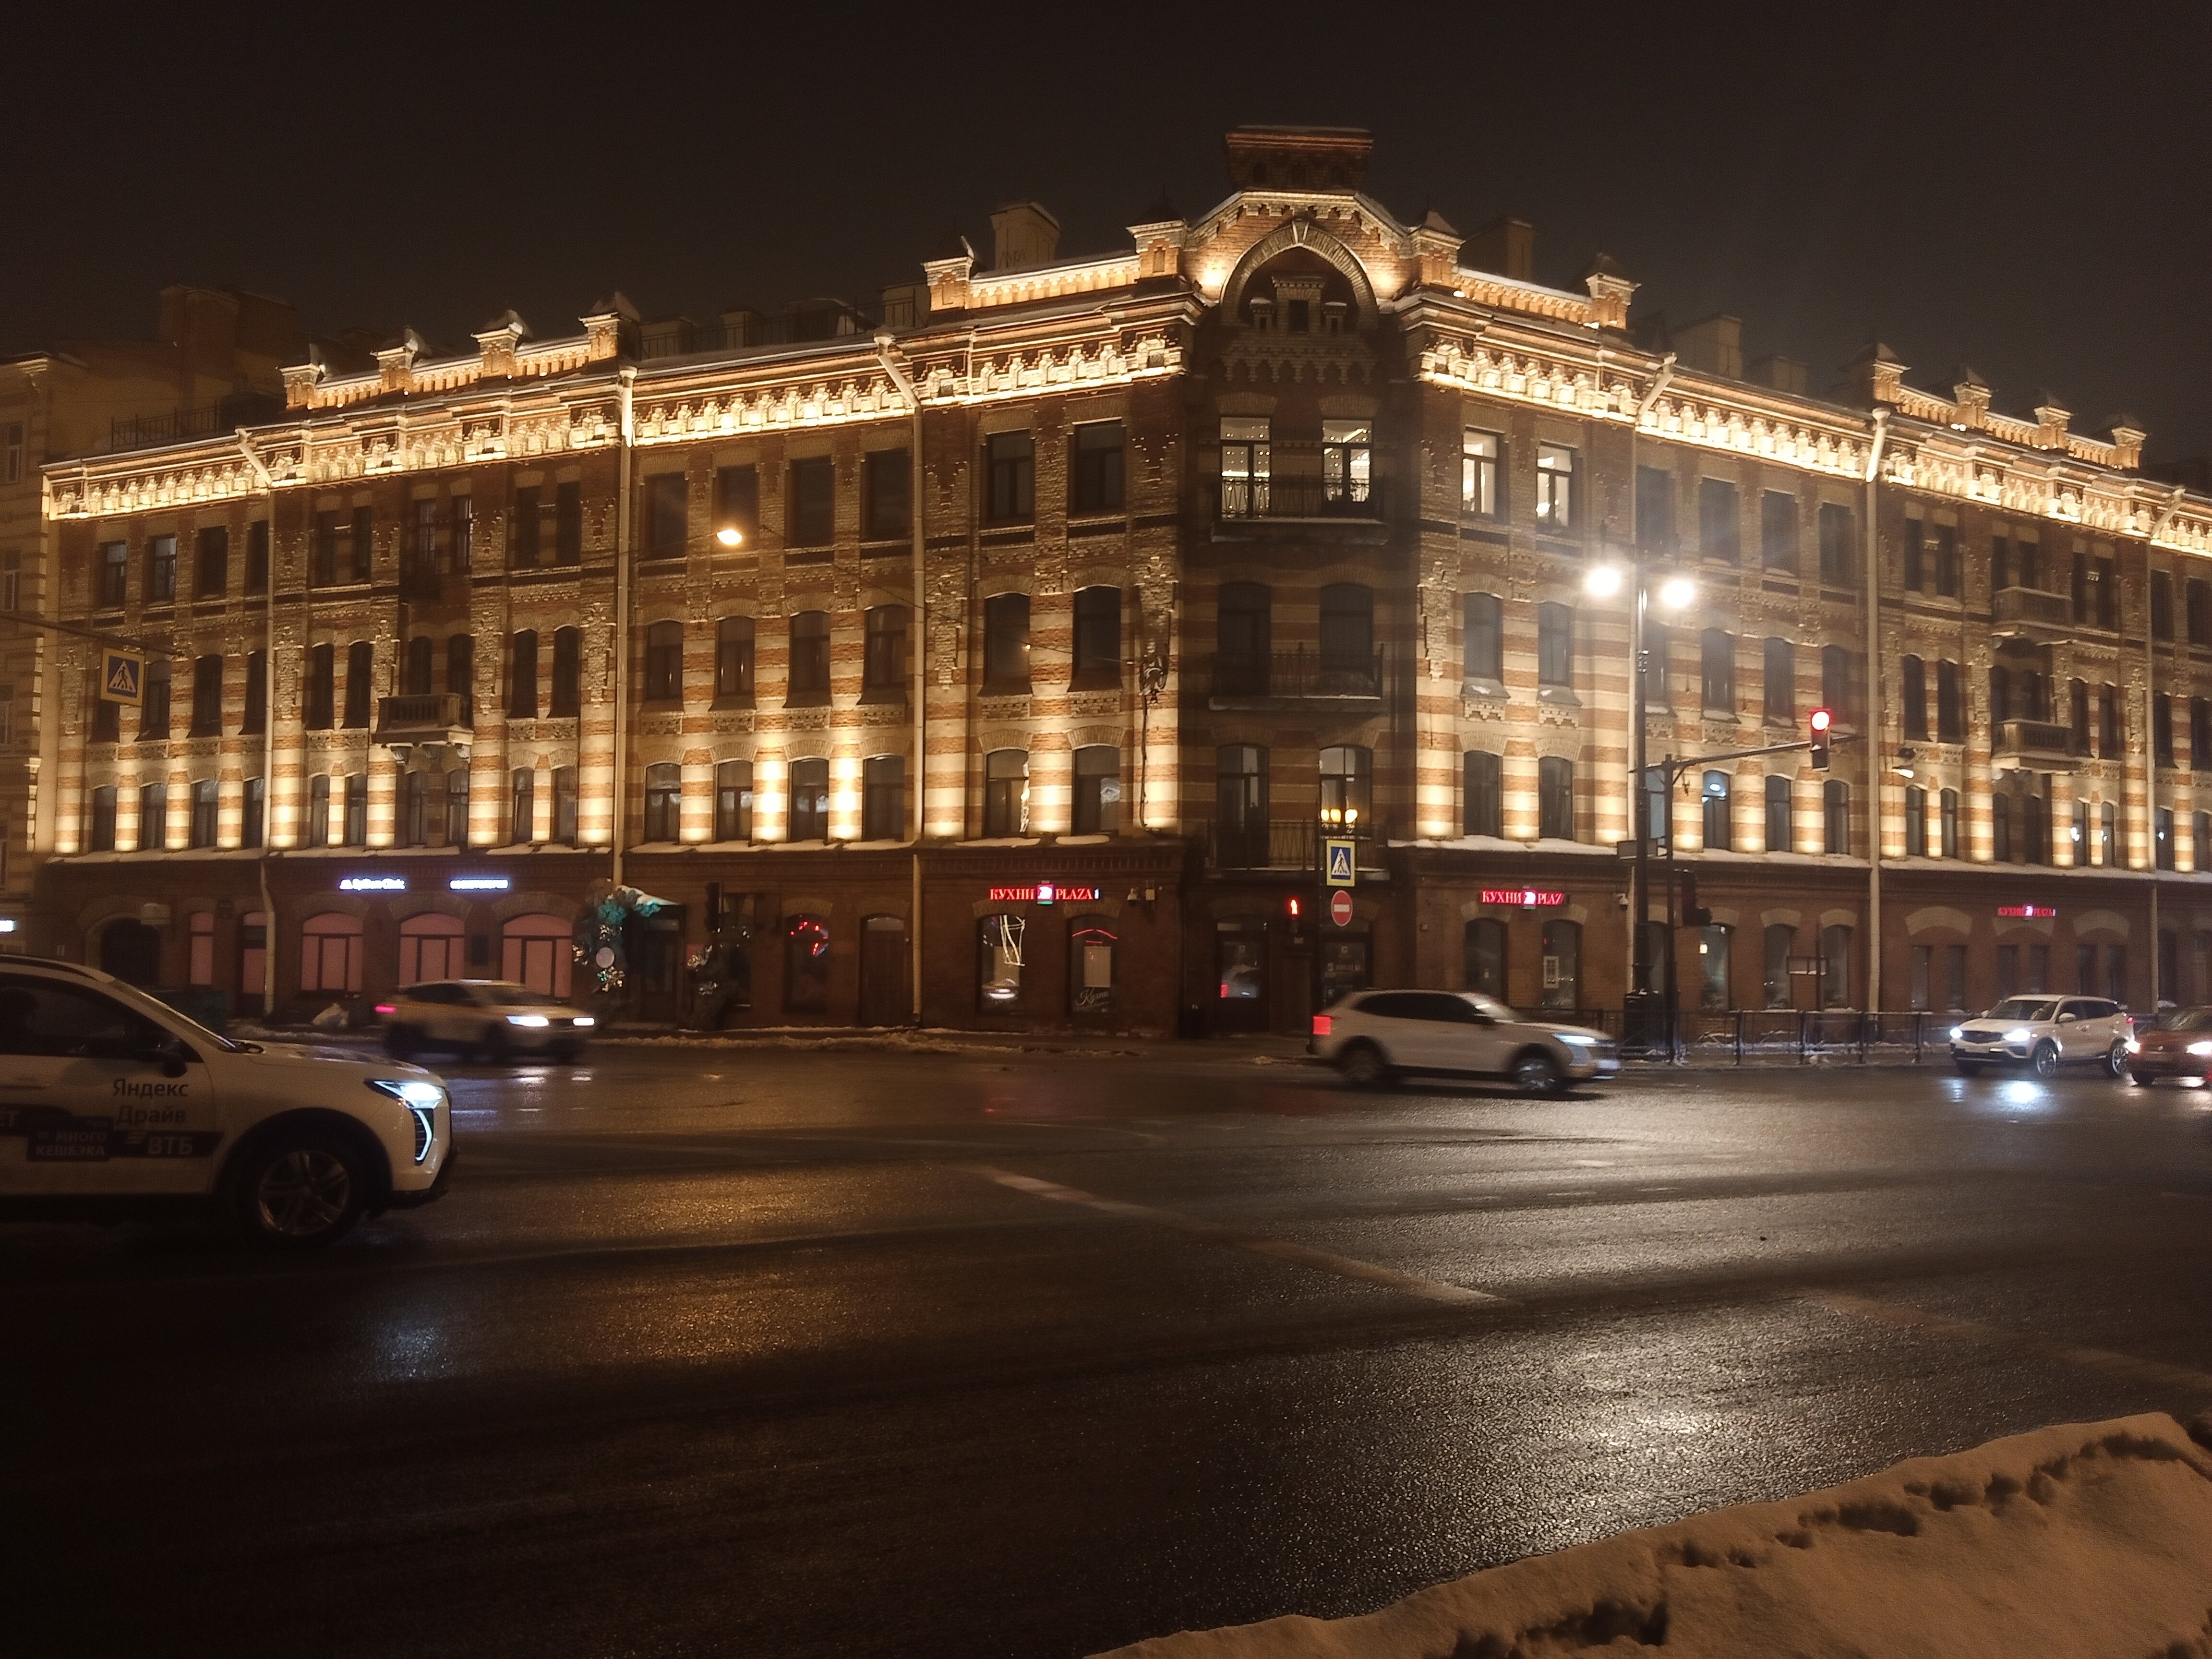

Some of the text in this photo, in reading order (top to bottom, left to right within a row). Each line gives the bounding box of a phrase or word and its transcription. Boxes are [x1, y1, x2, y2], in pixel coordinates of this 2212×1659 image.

[990, 888, 1034, 900] КУХНИ
[1055, 888, 1093, 900] PLAZA
[1482, 890, 1522, 904] КУХНИ
[112, 1078, 189, 1099] Яндекс
[115, 1105, 187, 1126] Драйв
[55, 1130, 107, 1142] МНОГО
[36, 1144, 105, 1156] КЕШБЭКА
[147, 1136, 193, 1155] ВТБ
